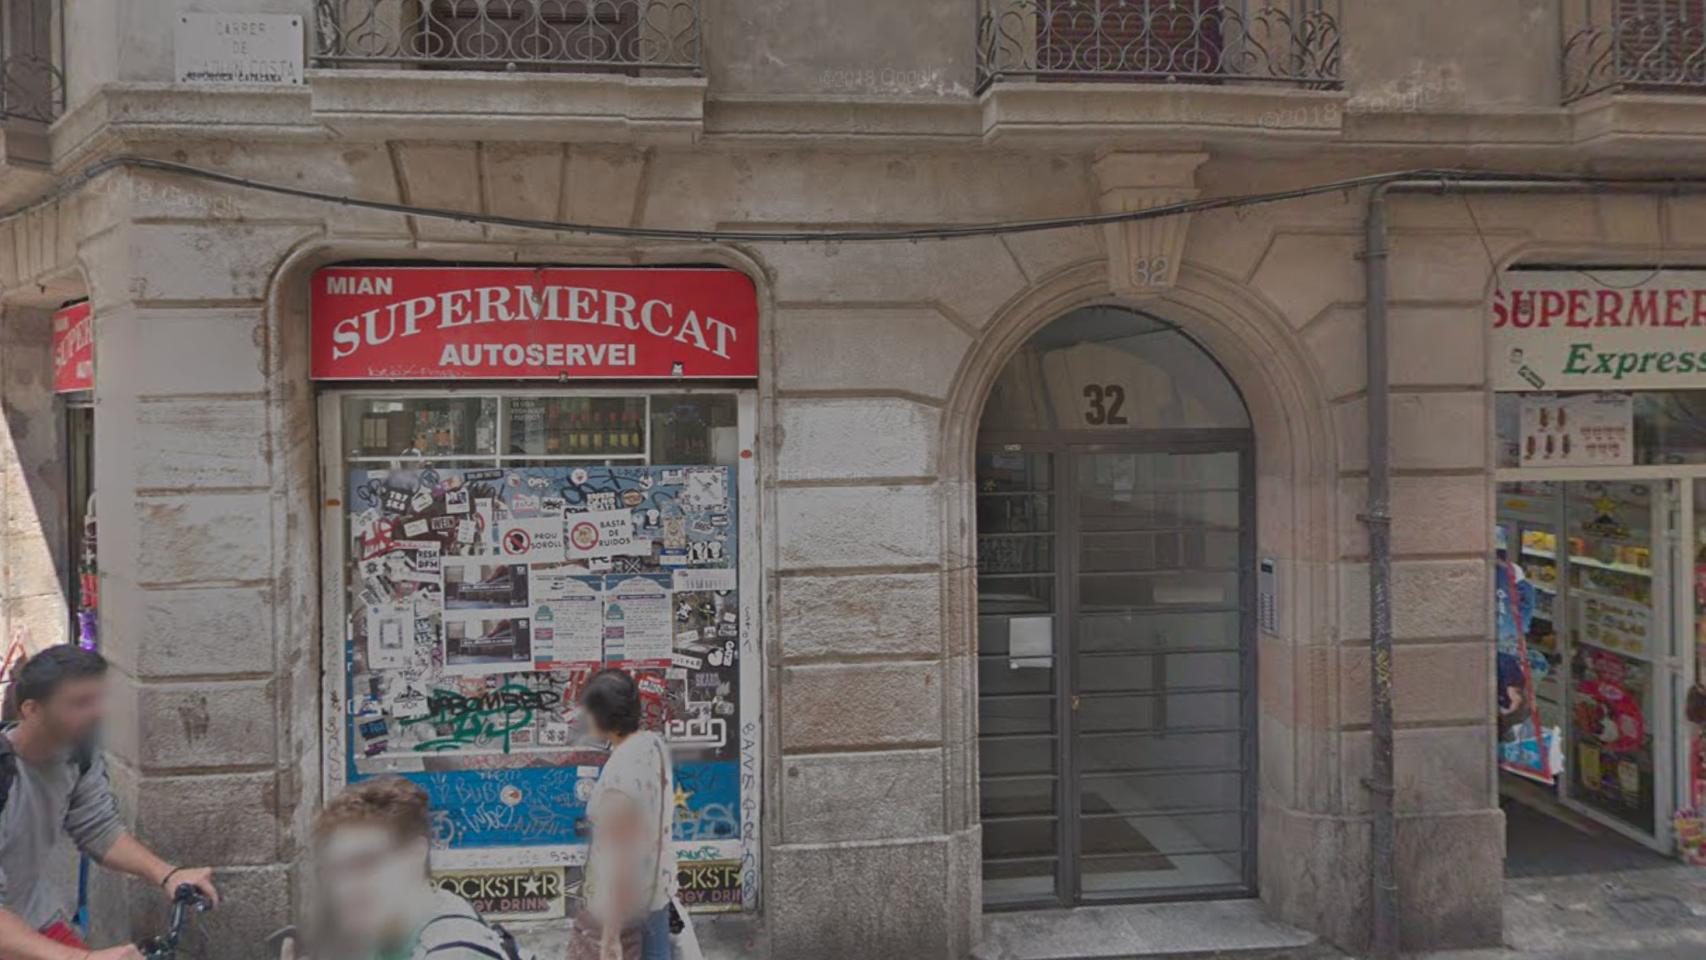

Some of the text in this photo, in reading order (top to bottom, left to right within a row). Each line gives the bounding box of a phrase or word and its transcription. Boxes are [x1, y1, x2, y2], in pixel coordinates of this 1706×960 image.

[232, 40, 249, 54] DE
[1132, 256, 1169, 288] 32
[326, 276, 393, 296] MIAN
[332, 284, 737, 360] SUPERMERCAT
[438, 342, 636, 367] AUTOSERVEI
[1082, 383, 1129, 426] 32
[600, 519, 626, 529] BASTA
[608, 529, 620, 537] DE
[531, 540, 563, 550] SOROLL
[599, 538, 632, 547] RUIDOS
[500, 898, 548, 911] DRINK
